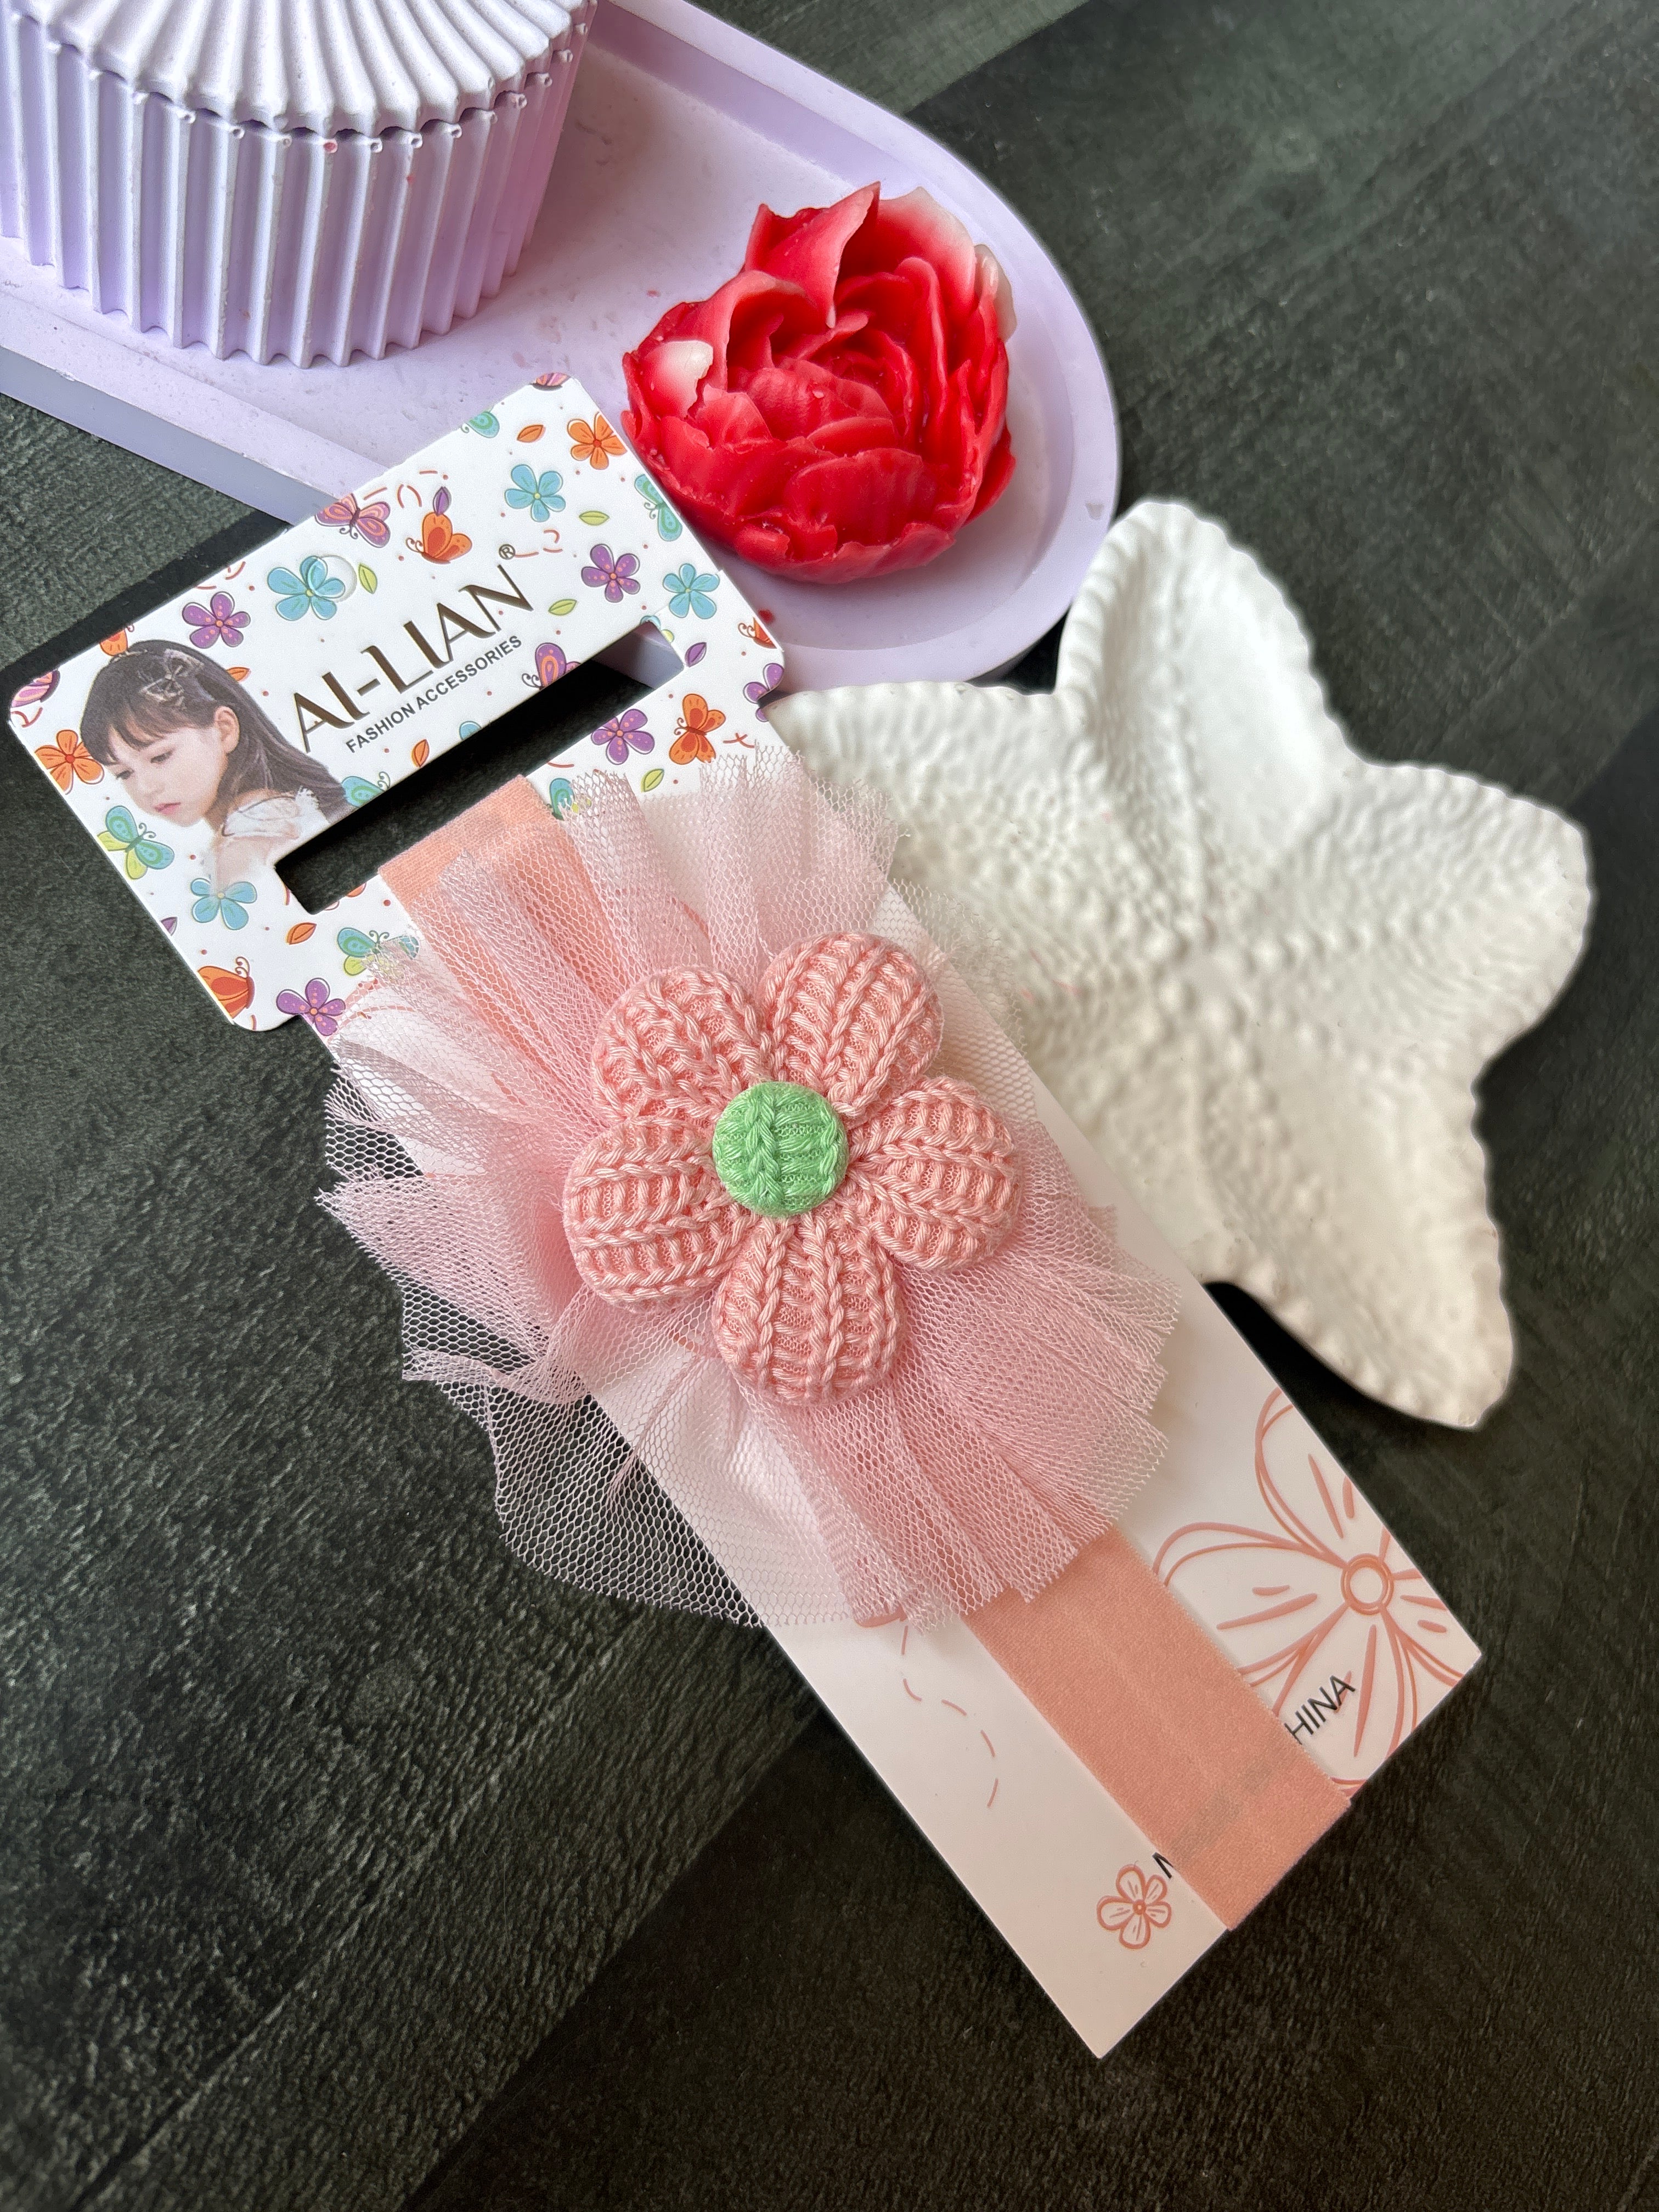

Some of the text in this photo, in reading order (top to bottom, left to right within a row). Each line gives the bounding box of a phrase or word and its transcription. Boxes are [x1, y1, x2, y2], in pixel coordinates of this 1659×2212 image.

[294, 564, 534, 754] AI-LIAN
[345, 635, 523, 753] FASHION ACCESSORIES
[1284, 1675, 1356, 1746] HINA
